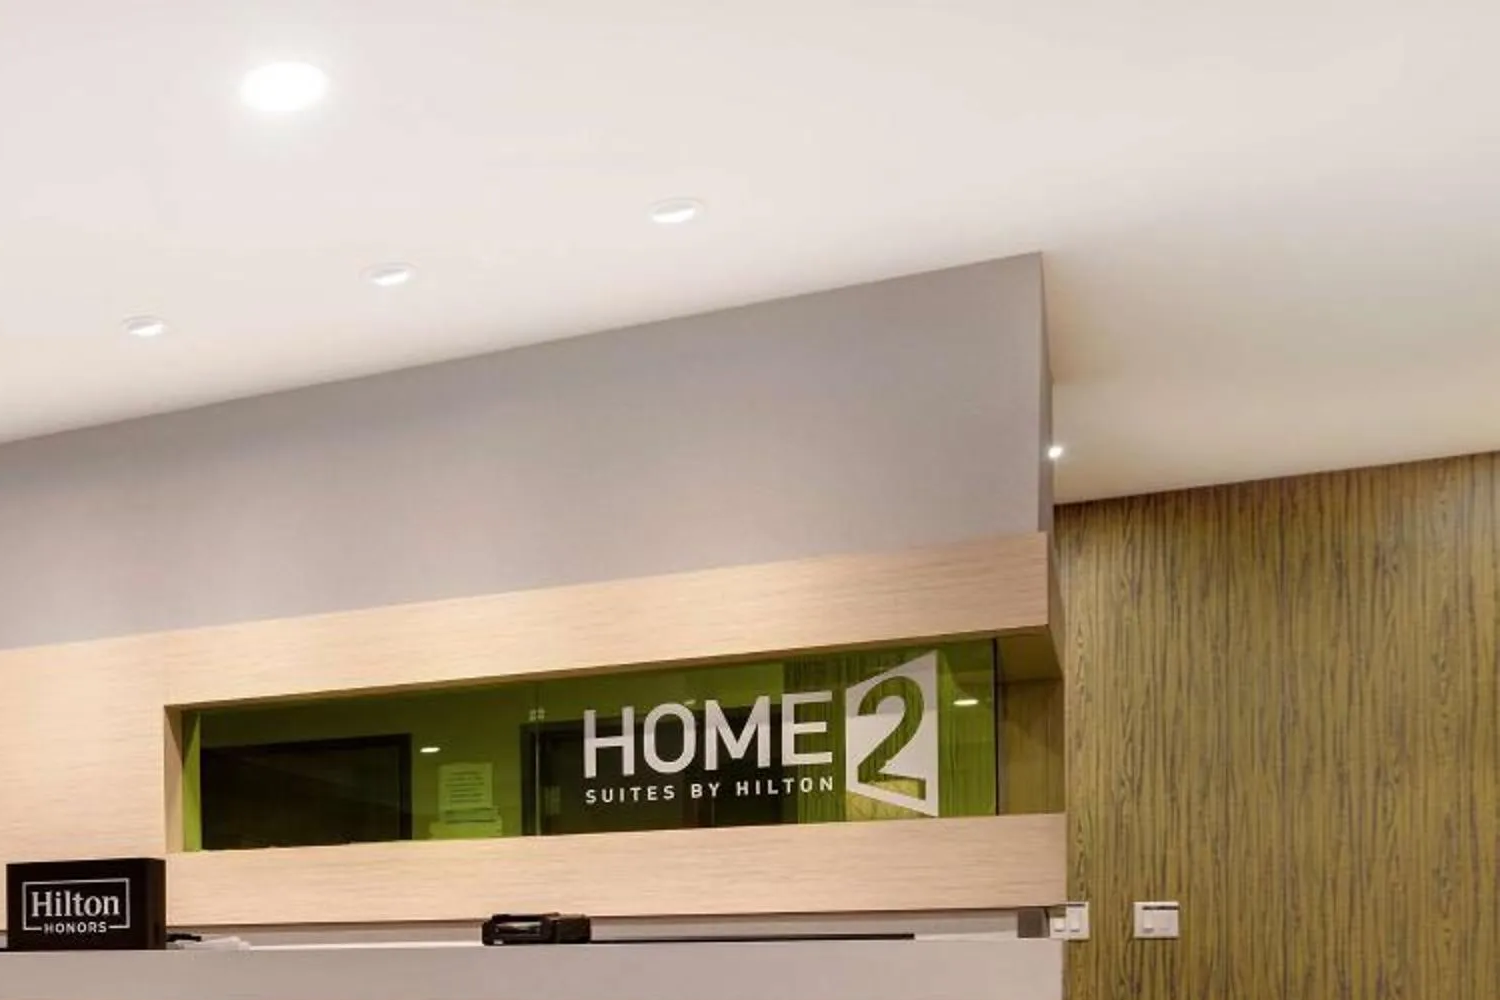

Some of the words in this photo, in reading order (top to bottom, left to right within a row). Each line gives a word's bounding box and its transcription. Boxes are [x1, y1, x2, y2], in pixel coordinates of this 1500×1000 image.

[583, 690, 833, 778] HOME
[586, 786, 675, 804] SUITES
[691, 782, 722, 799] BY
[736, 776, 833, 797] HILTON
[31, 890, 120, 917] Hilton
[44, 921, 107, 935] HONORS
